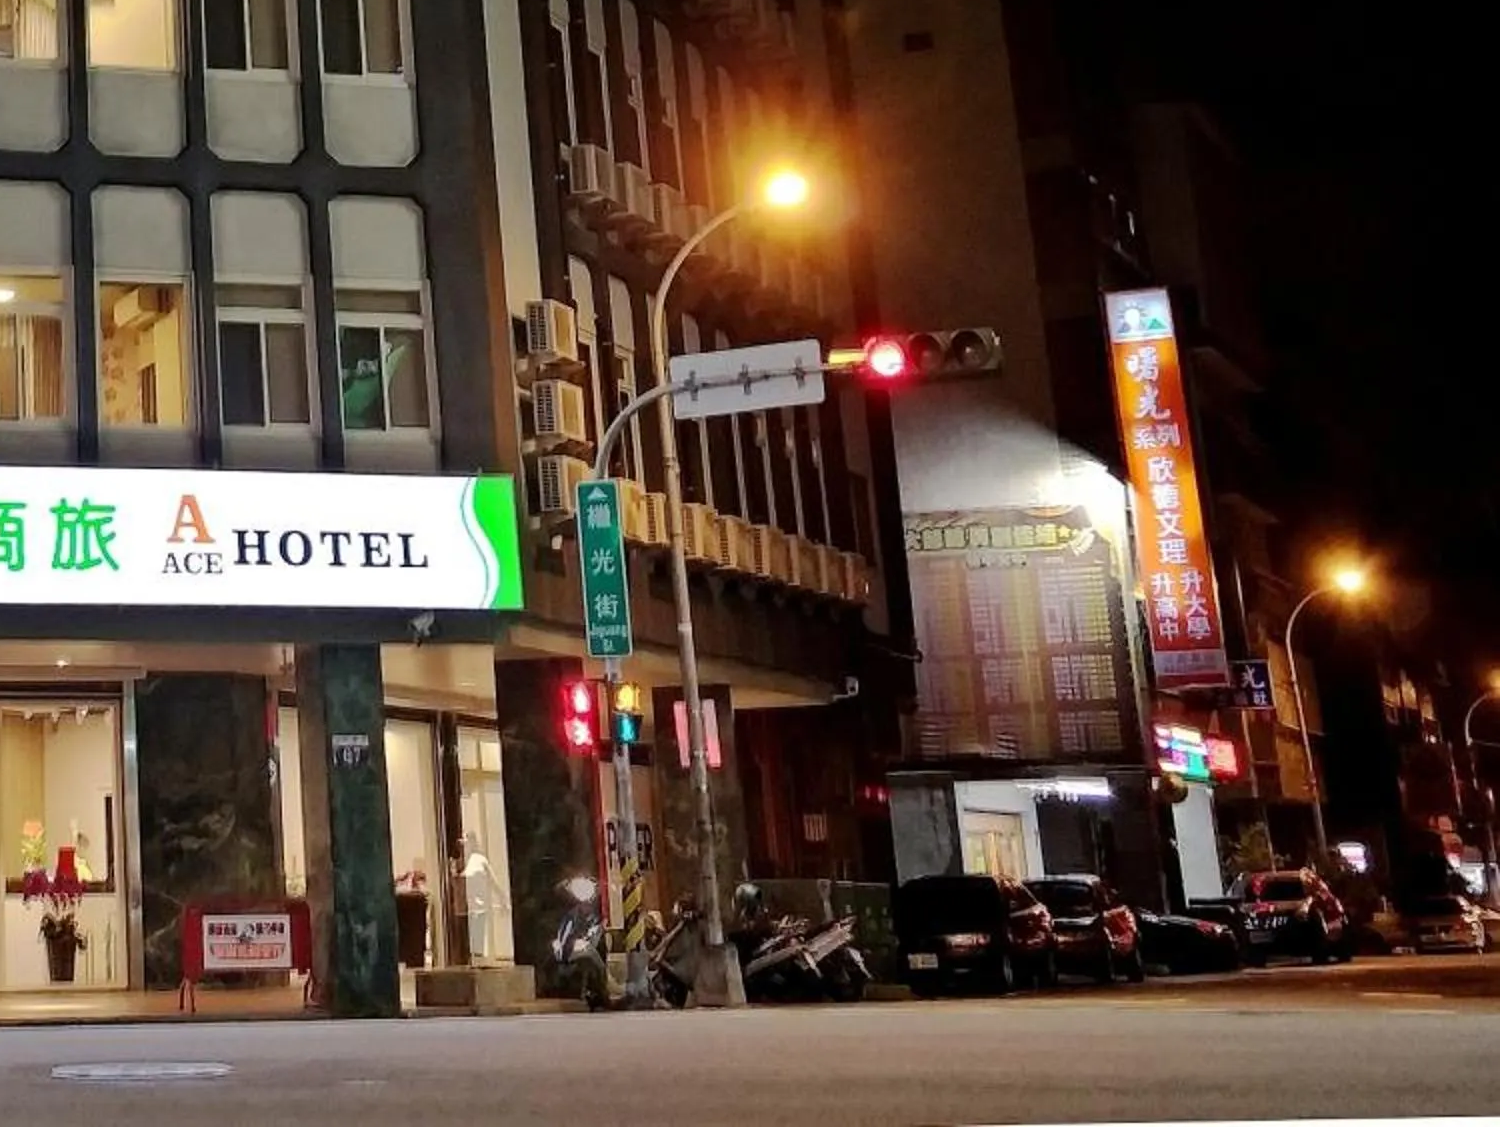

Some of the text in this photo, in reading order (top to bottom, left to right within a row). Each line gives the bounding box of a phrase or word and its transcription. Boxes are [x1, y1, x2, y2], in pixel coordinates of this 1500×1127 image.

[166, 494, 216, 544] A
[162, 529, 430, 575] ACE HOTEL
